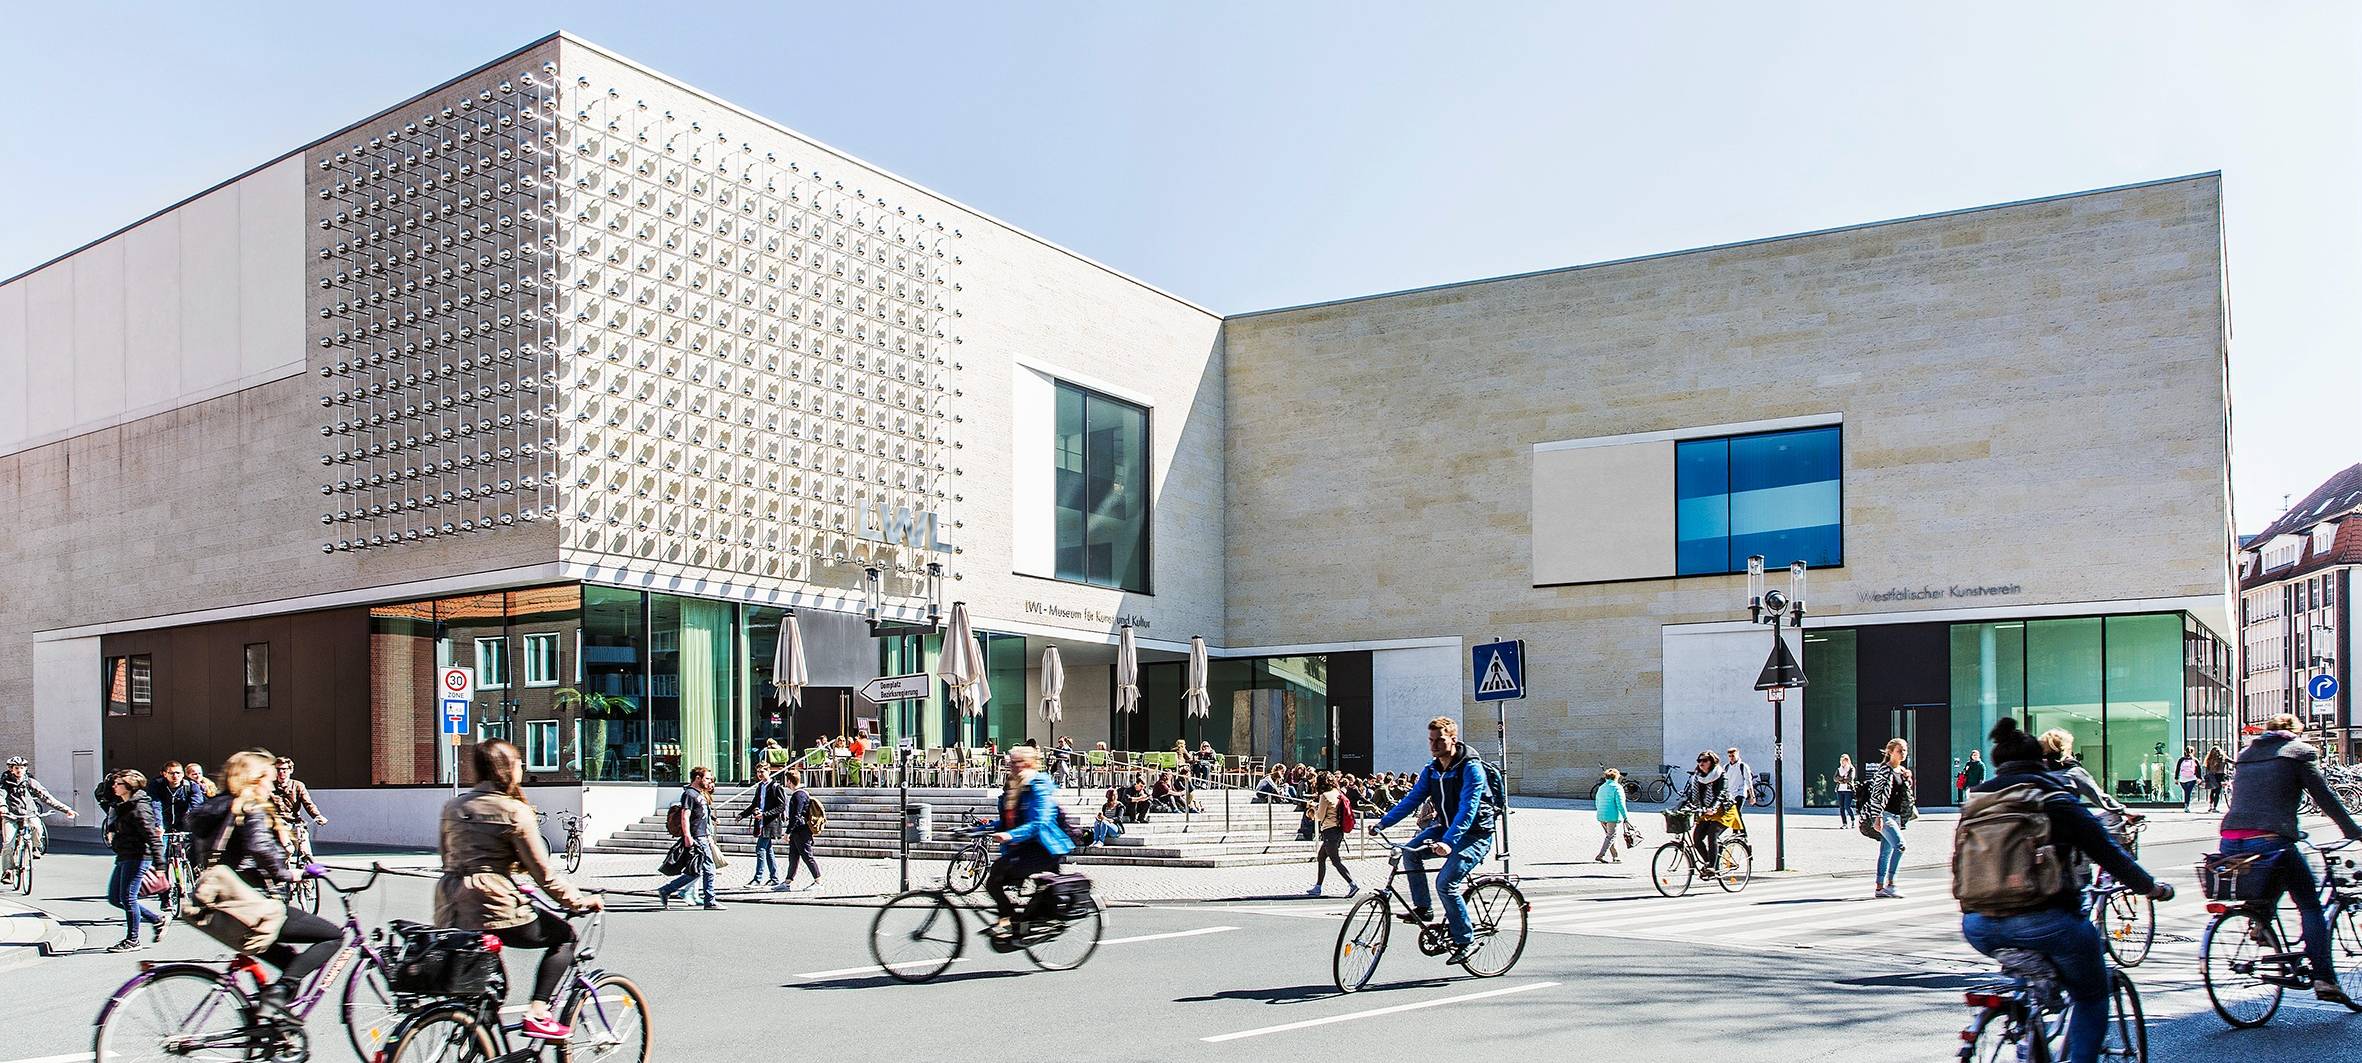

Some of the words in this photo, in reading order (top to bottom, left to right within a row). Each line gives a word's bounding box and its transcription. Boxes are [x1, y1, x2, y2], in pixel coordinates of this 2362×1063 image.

[855, 498, 952, 554] LWL
[1949, 583, 2021, 598] Kunstverein
[1116, 613, 1130, 625] und
[1131, 615, 1151, 629] Kultur
[449, 675, 463, 686] 30
[880, 681, 902, 690] Domplatz
